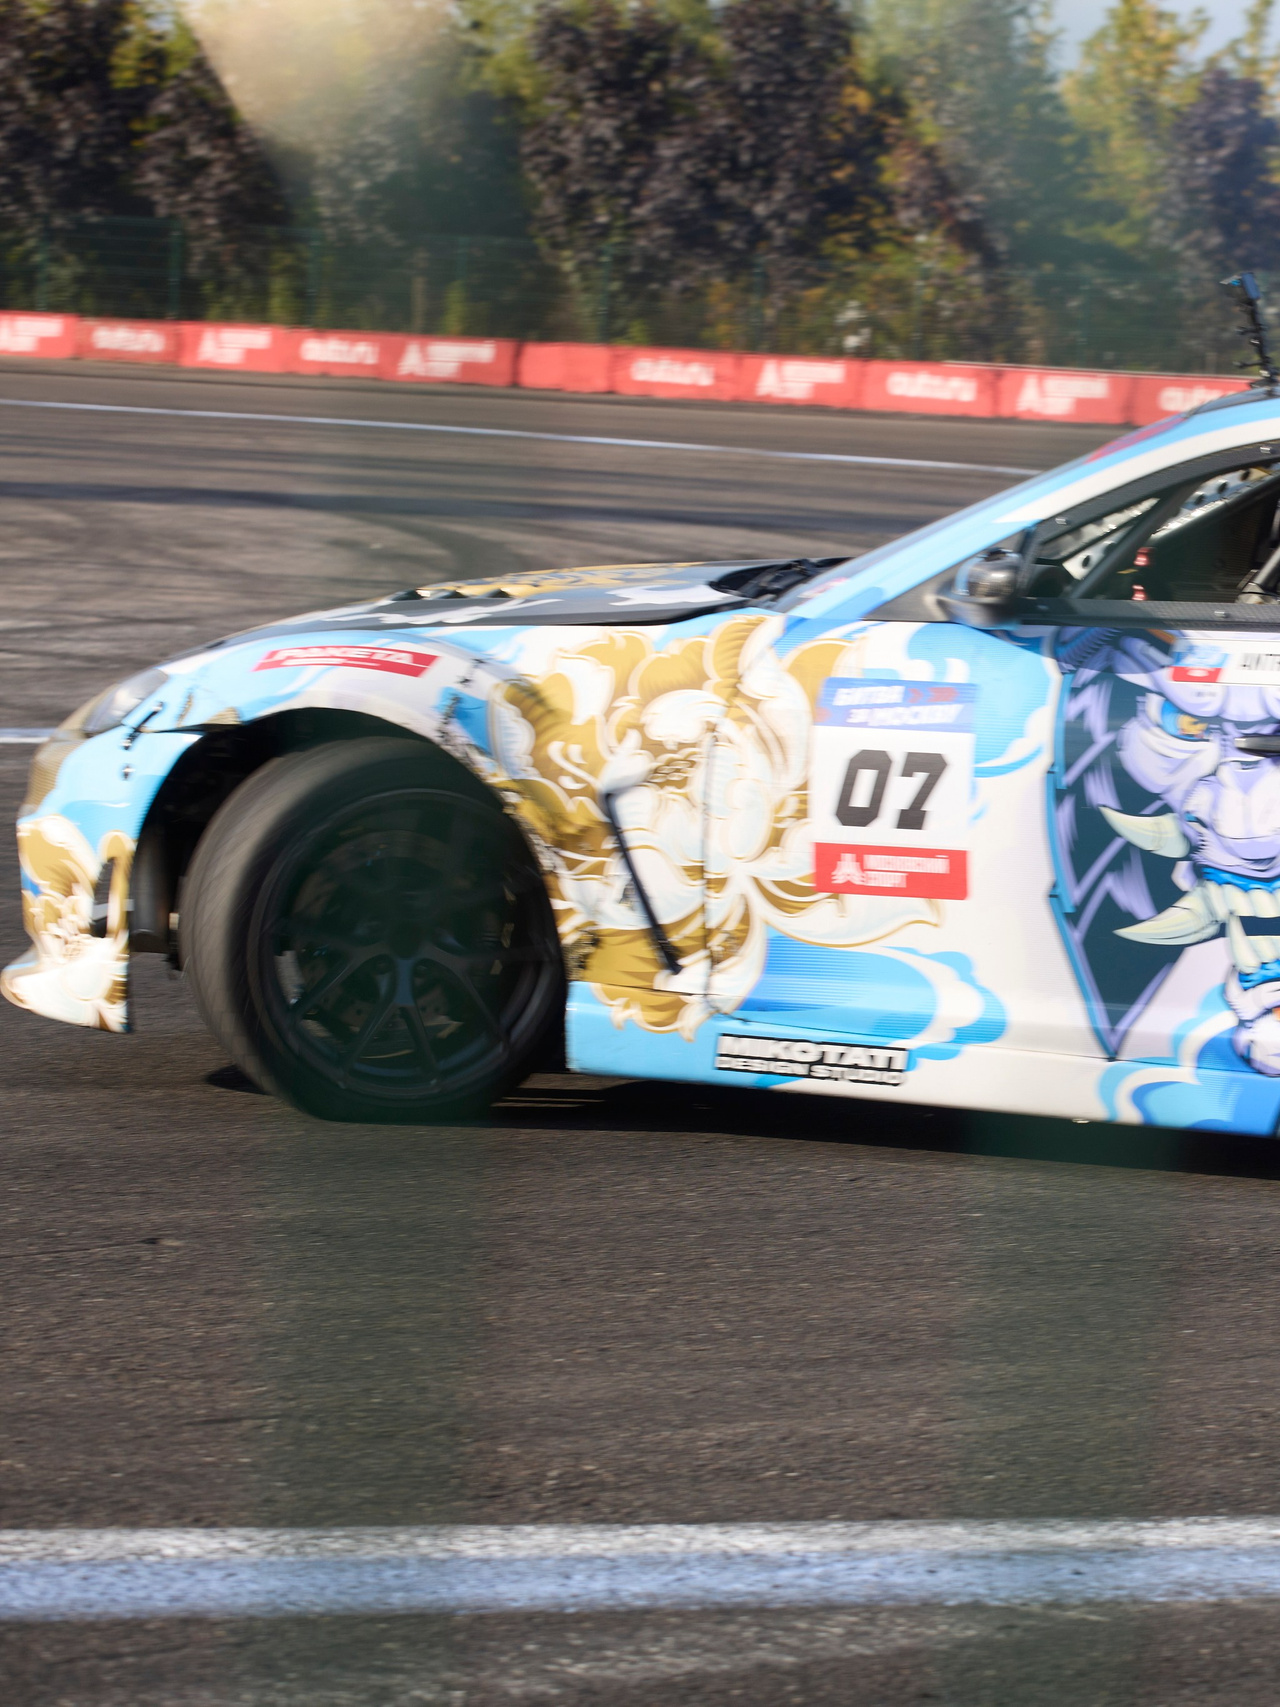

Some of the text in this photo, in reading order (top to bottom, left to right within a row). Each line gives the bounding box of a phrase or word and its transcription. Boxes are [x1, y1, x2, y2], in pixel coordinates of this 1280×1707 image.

[835, 749, 948, 830] 07
[715, 1056, 906, 1085] DESIGN STUDIO
